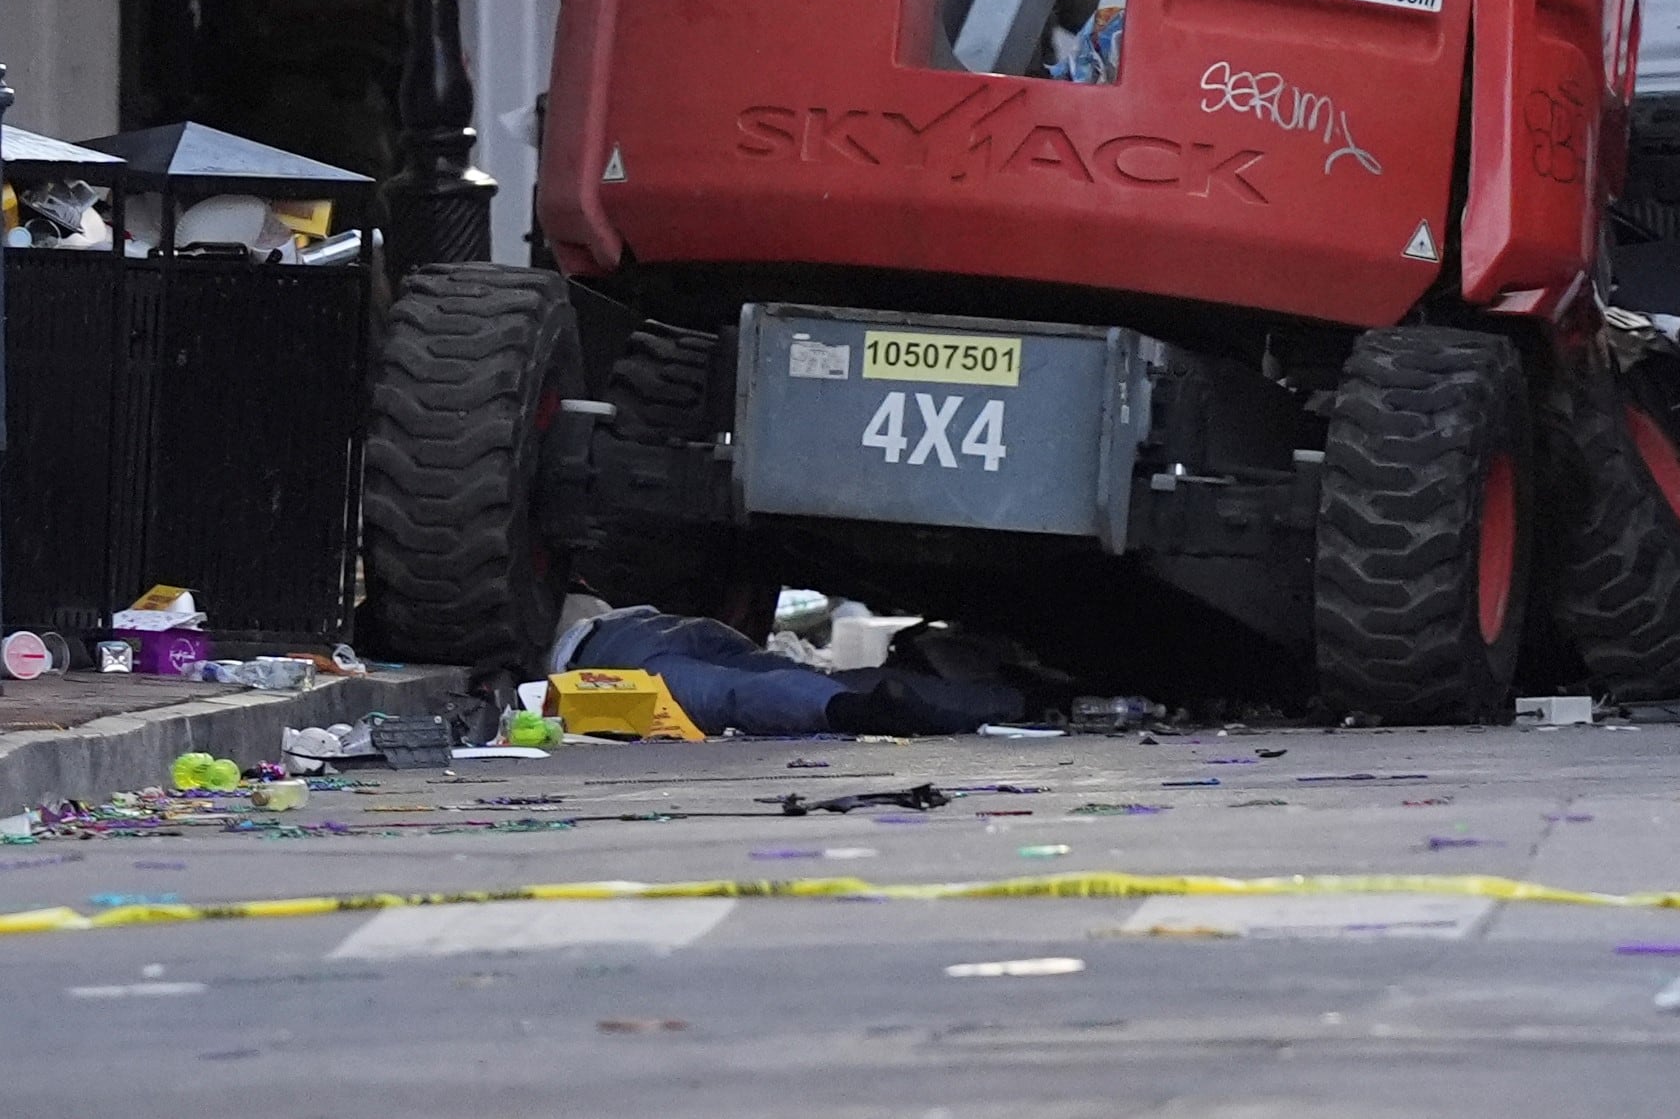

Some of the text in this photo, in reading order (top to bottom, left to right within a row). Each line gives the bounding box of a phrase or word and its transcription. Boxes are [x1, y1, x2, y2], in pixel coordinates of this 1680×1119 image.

[736, 83, 1271, 205] SKYJACK
[866, 340, 1016, 373] 10507501
[862, 391, 1007, 472] 4X4
